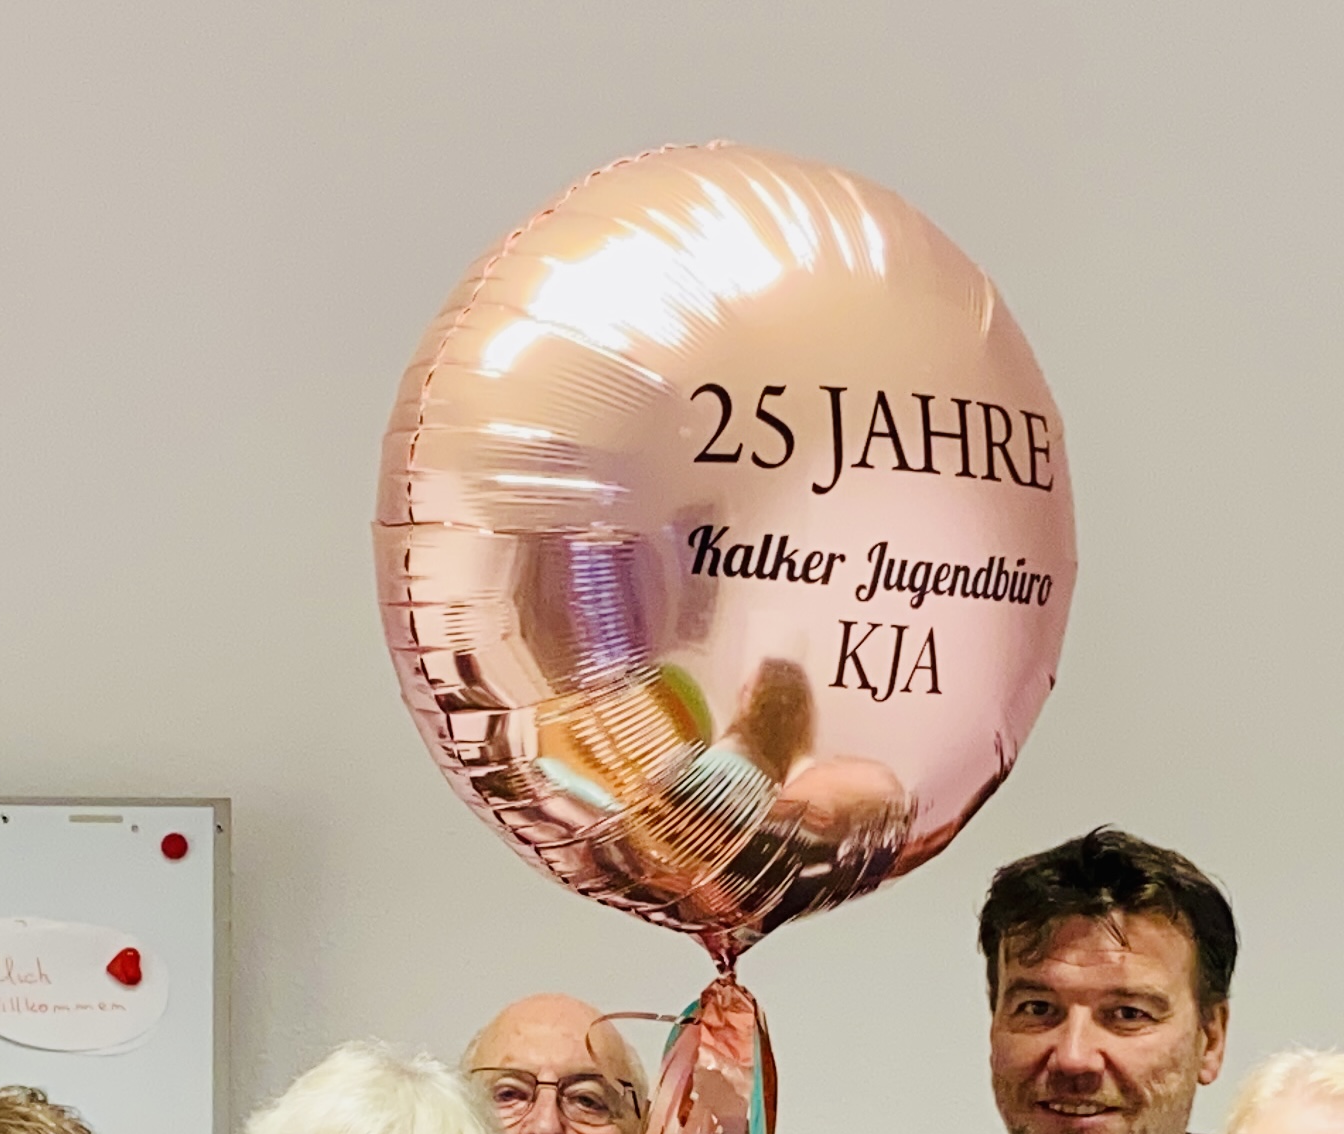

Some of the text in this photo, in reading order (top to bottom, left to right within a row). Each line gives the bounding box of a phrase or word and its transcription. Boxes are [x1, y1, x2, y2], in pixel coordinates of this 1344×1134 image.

[690, 383, 1054, 494] 25 JAHRE
[688, 525, 1053, 609] Kalker Jugendbüro
[829, 620, 943, 702] KJA
